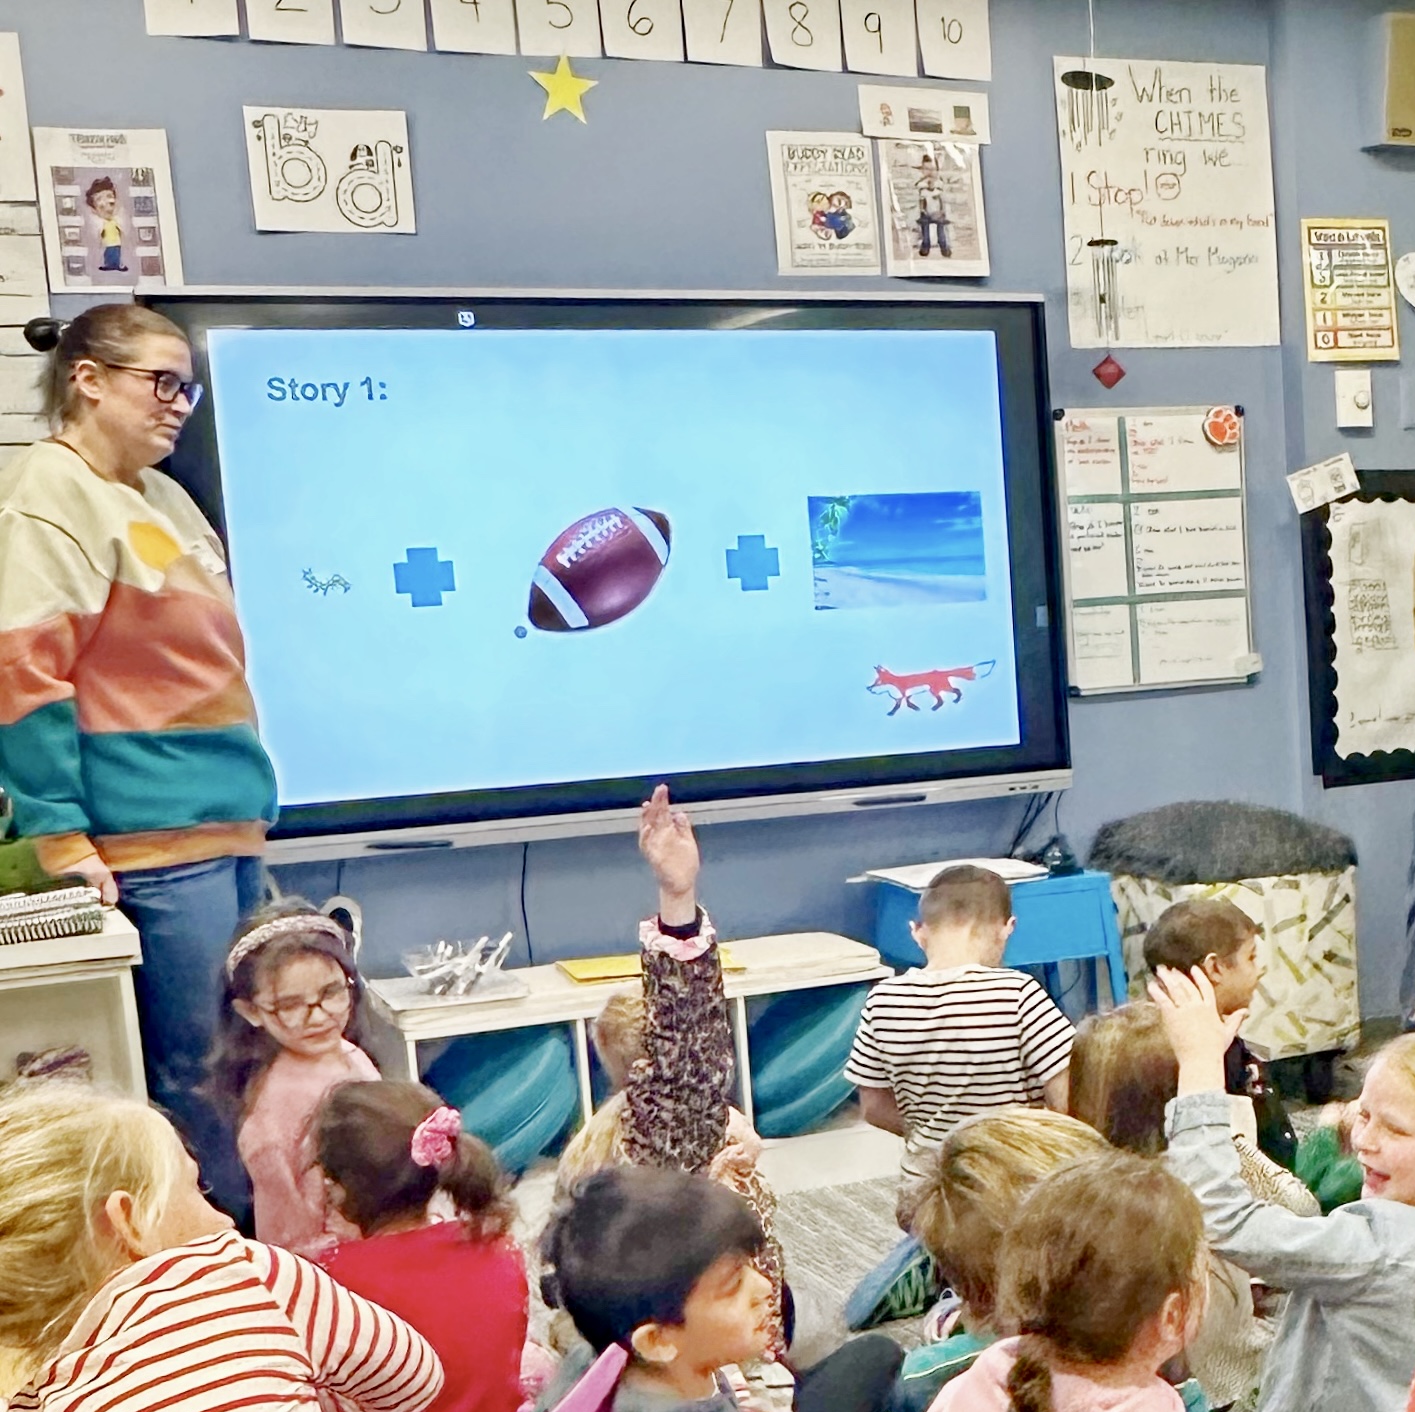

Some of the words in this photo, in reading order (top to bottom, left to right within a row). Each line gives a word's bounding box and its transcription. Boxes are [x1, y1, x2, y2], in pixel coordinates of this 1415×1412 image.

[627, 0, 655, 36] 6
[788, 1, 814, 47] 8
[864, 12, 884, 54] 9
[940, 16, 964, 45] 10
[1128, 65, 1192, 104] When
[1209, 74, 1241, 103] the
[1155, 109, 1246, 138] CHIMES
[1144, 147, 1187, 177] ring
[1203, 150, 1232, 167] we
[1069, 235, 1083, 266] 2
[267, 377, 350, 407] Story
[360, 376, 388, 400] 1:
